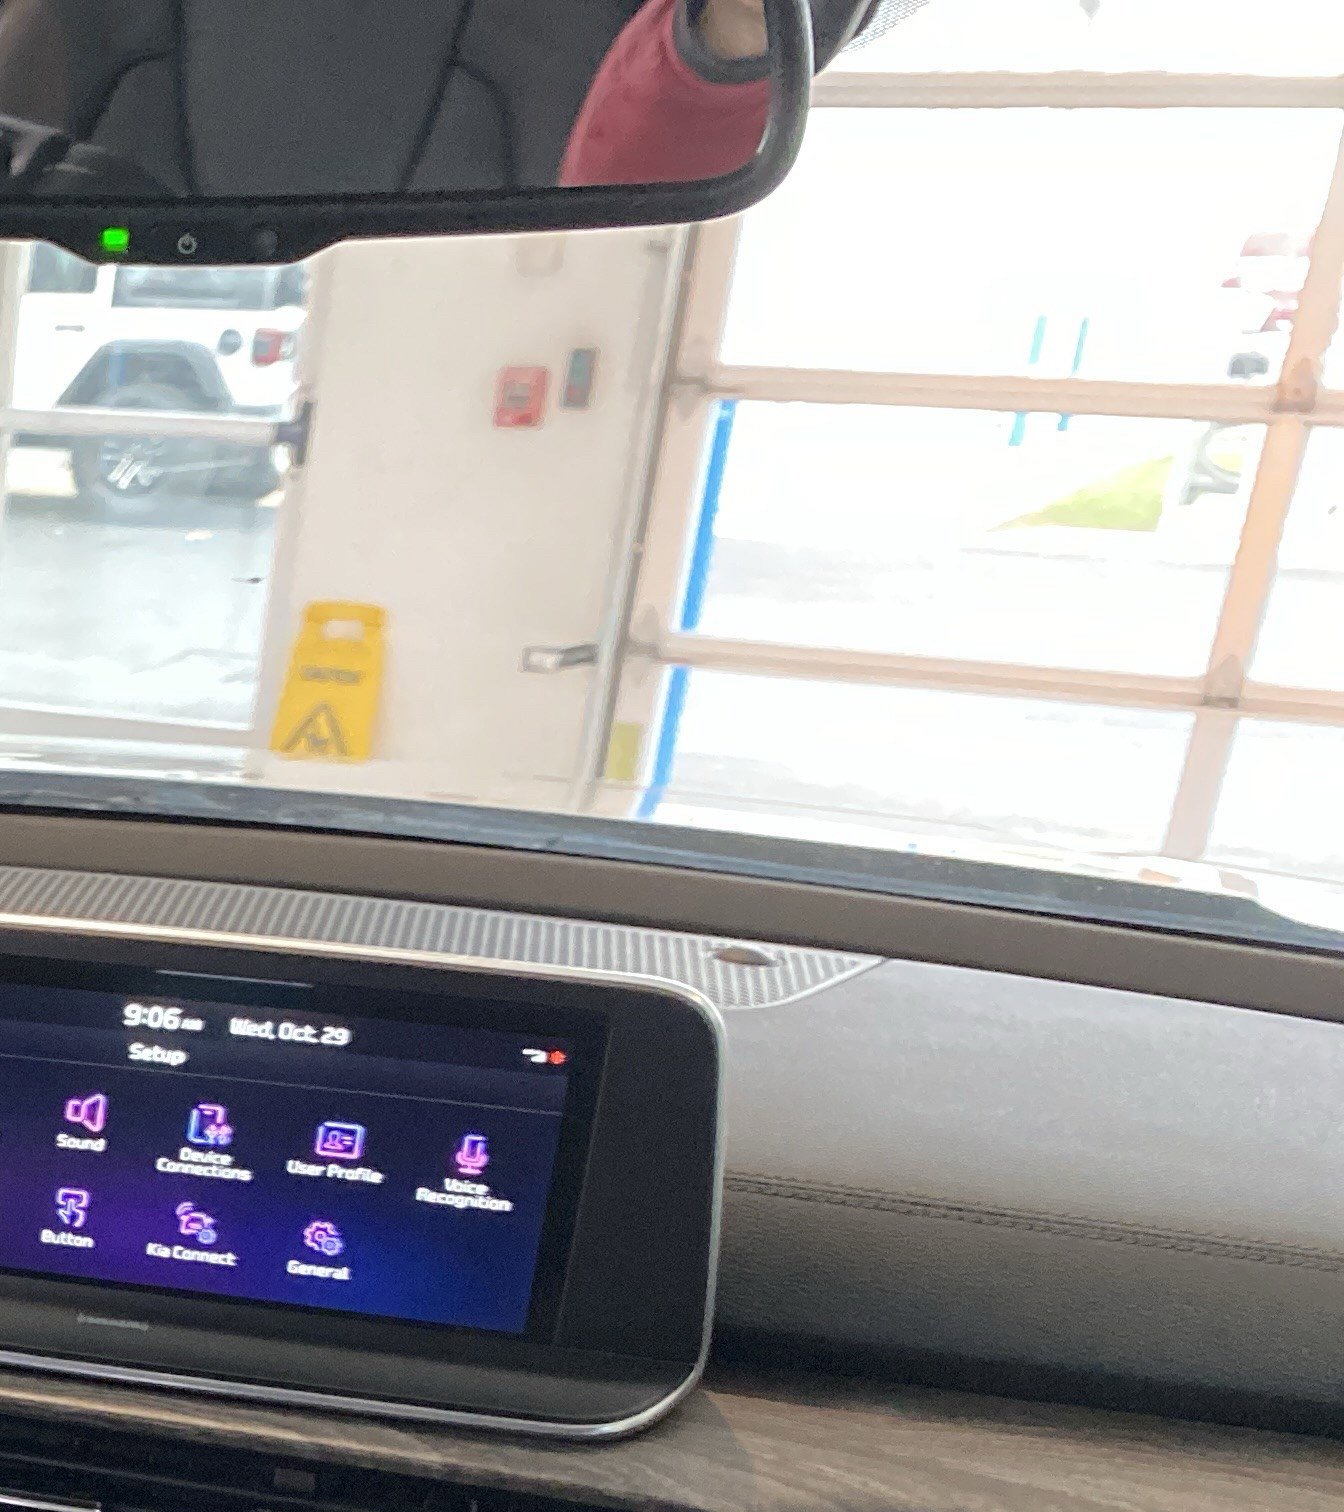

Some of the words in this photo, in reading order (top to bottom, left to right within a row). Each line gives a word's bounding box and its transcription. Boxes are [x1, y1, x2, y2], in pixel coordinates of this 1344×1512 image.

[320, 1026, 353, 1046] 29
[127, 1042, 188, 1066] Setup
[56, 1133, 106, 1152] Sound
[178, 1147, 234, 1166] Device
[155, 1157, 255, 1182] Connections
[286, 1159, 326, 1177] User
[326, 1163, 385, 1184] Profile
[443, 1177, 490, 1196] Voice
[415, 1187, 514, 1212] Recognition
[40, 1228, 95, 1248] Button
[145, 1242, 172, 1258] Kia
[172, 1245, 239, 1267] Connect
[286, 1259, 352, 1281] General
